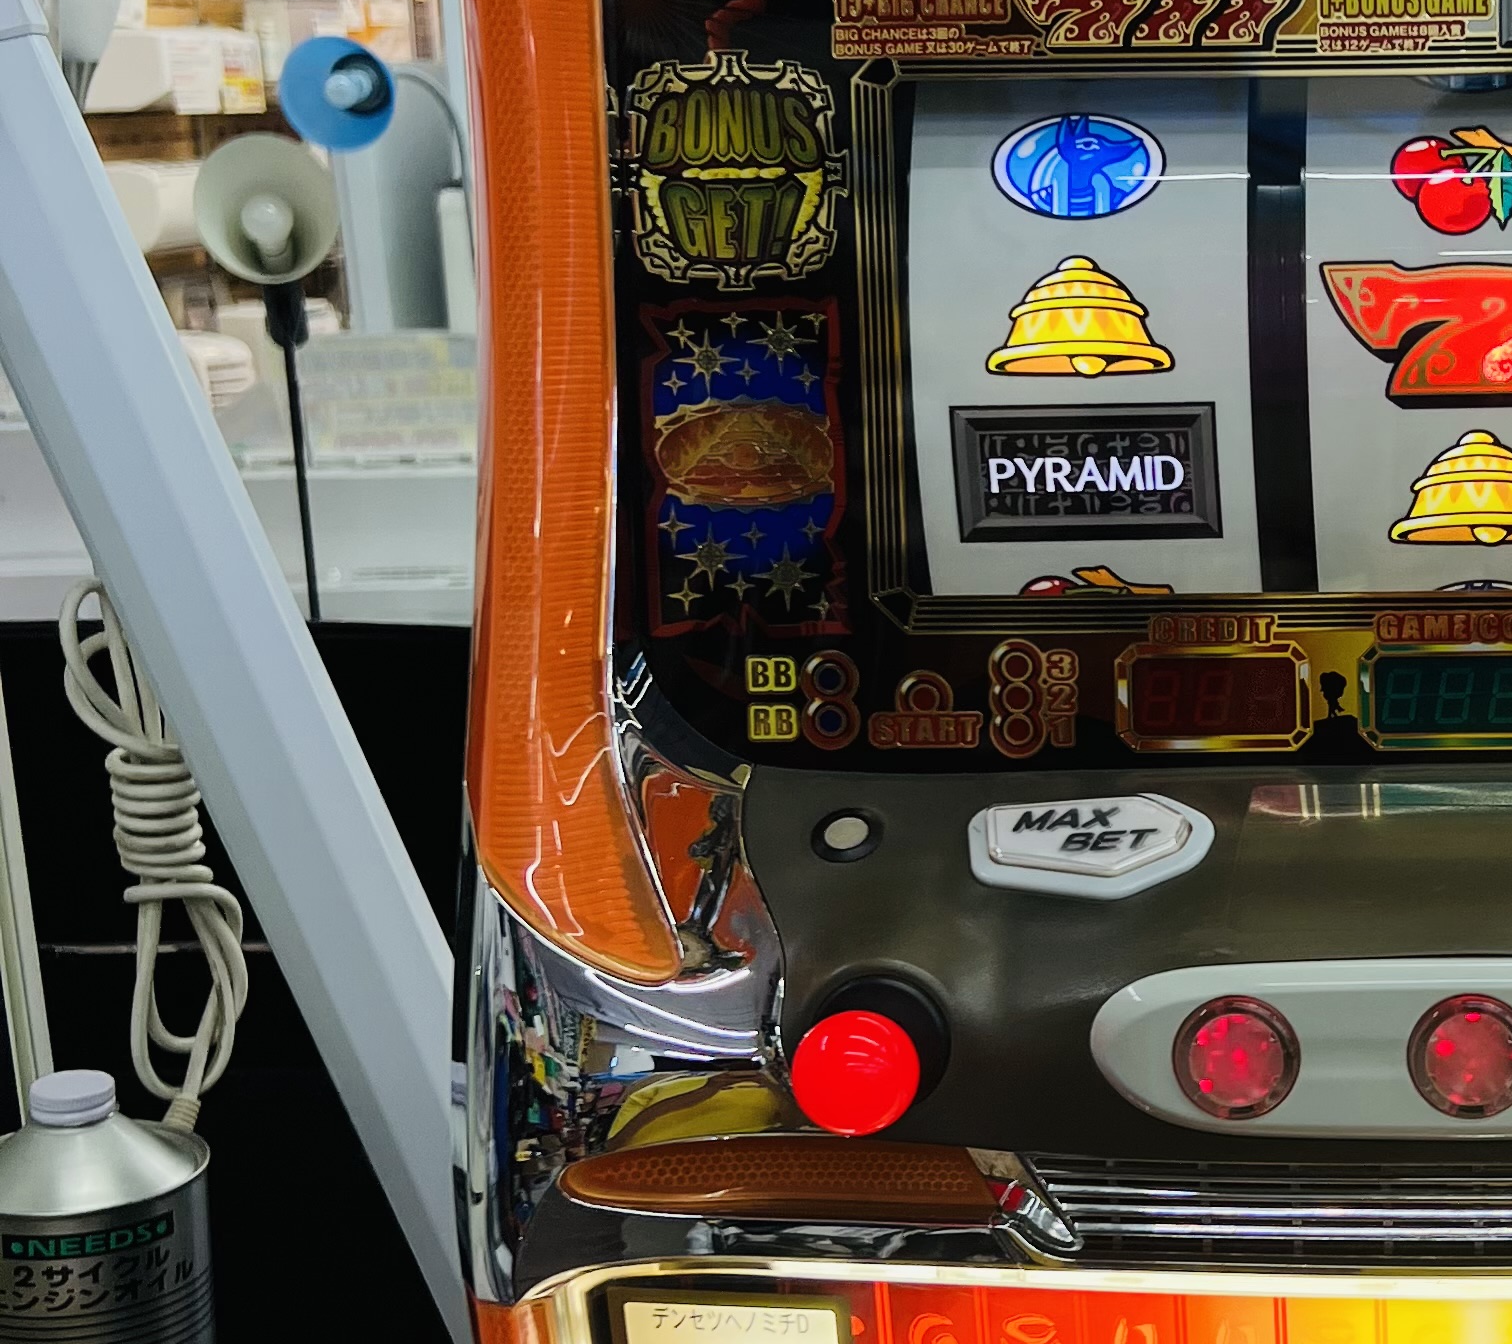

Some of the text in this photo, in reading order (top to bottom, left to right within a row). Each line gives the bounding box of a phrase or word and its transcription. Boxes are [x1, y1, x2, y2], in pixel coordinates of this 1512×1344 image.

[835, 29, 859, 41] BIG
[1320, 26, 1368, 38] BONUS
[835, 43, 883, 56] BONUS
[647, 87, 819, 165] BONUS
[663, 180, 804, 261] GET!
[988, 456, 1184, 495] PYRAMID
[1153, 616, 1274, 642] CREDIT
[1379, 615, 1470, 640] GAME
[751, 659, 793, 689] BB
[1051, 655, 1074, 679] 3
[1051, 685, 1074, 710] 2
[753, 707, 794, 737] RB
[877, 716, 976, 743] START
[1053, 718, 1073, 743] 1
[1013, 807, 1121, 832] MAX
[1061, 829, 1158, 852] BET
[14, 1245, 171, 1289] 2サイクル
